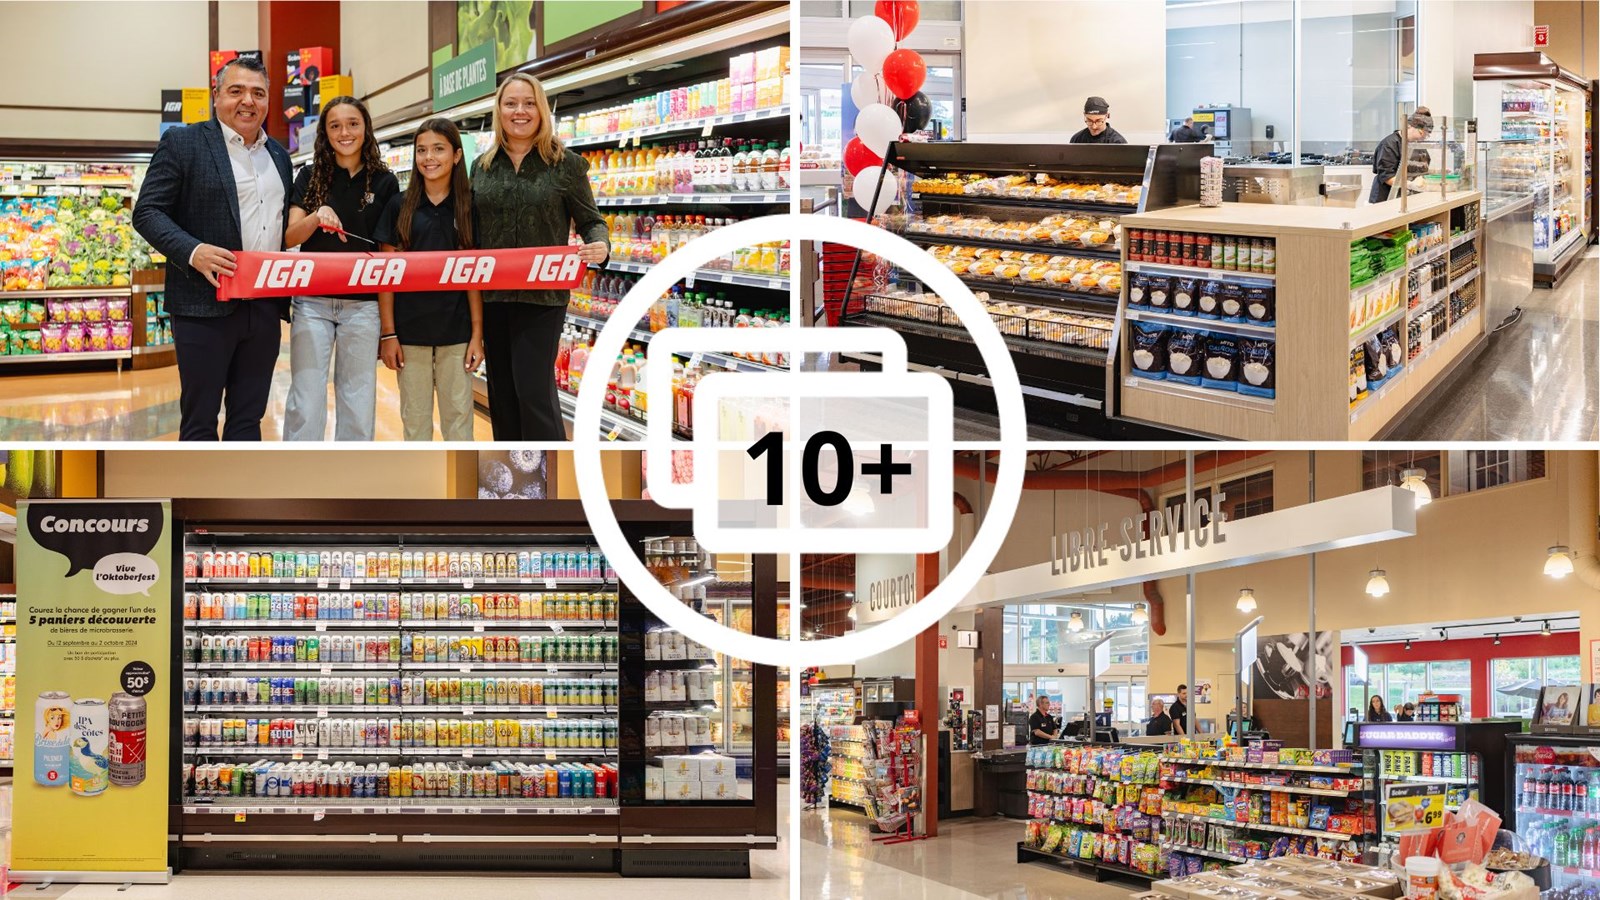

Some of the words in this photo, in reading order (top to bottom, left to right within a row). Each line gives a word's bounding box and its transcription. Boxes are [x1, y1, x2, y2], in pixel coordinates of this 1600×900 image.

[443, 71, 455, 96] BASE
[455, 68, 462, 91] DE
[462, 57, 487, 88] PLANTES
[164, 101, 182, 112] IGA
[347, 258, 407, 286] IGA
[438, 256, 496, 284] IGA
[526, 253, 582, 282] IGA
[254, 259, 315, 288] IGA
[40, 515, 149, 533] Concours
[1051, 492, 1226, 576] LIBRE-SERVICE
[115, 564, 136, 572] Vive
[96, 573, 155, 582] l'Oktoberfest
[102, 608, 127, 616] gagner
[29, 615, 36, 625] 5
[38, 615, 86, 626] paniers
[88, 615, 156, 625] découverte
[127, 676, 149, 688] 50$
[78, 716, 93, 725] IPA
[122, 711, 145, 719] PETITE
[81, 729, 103, 737] côtes
